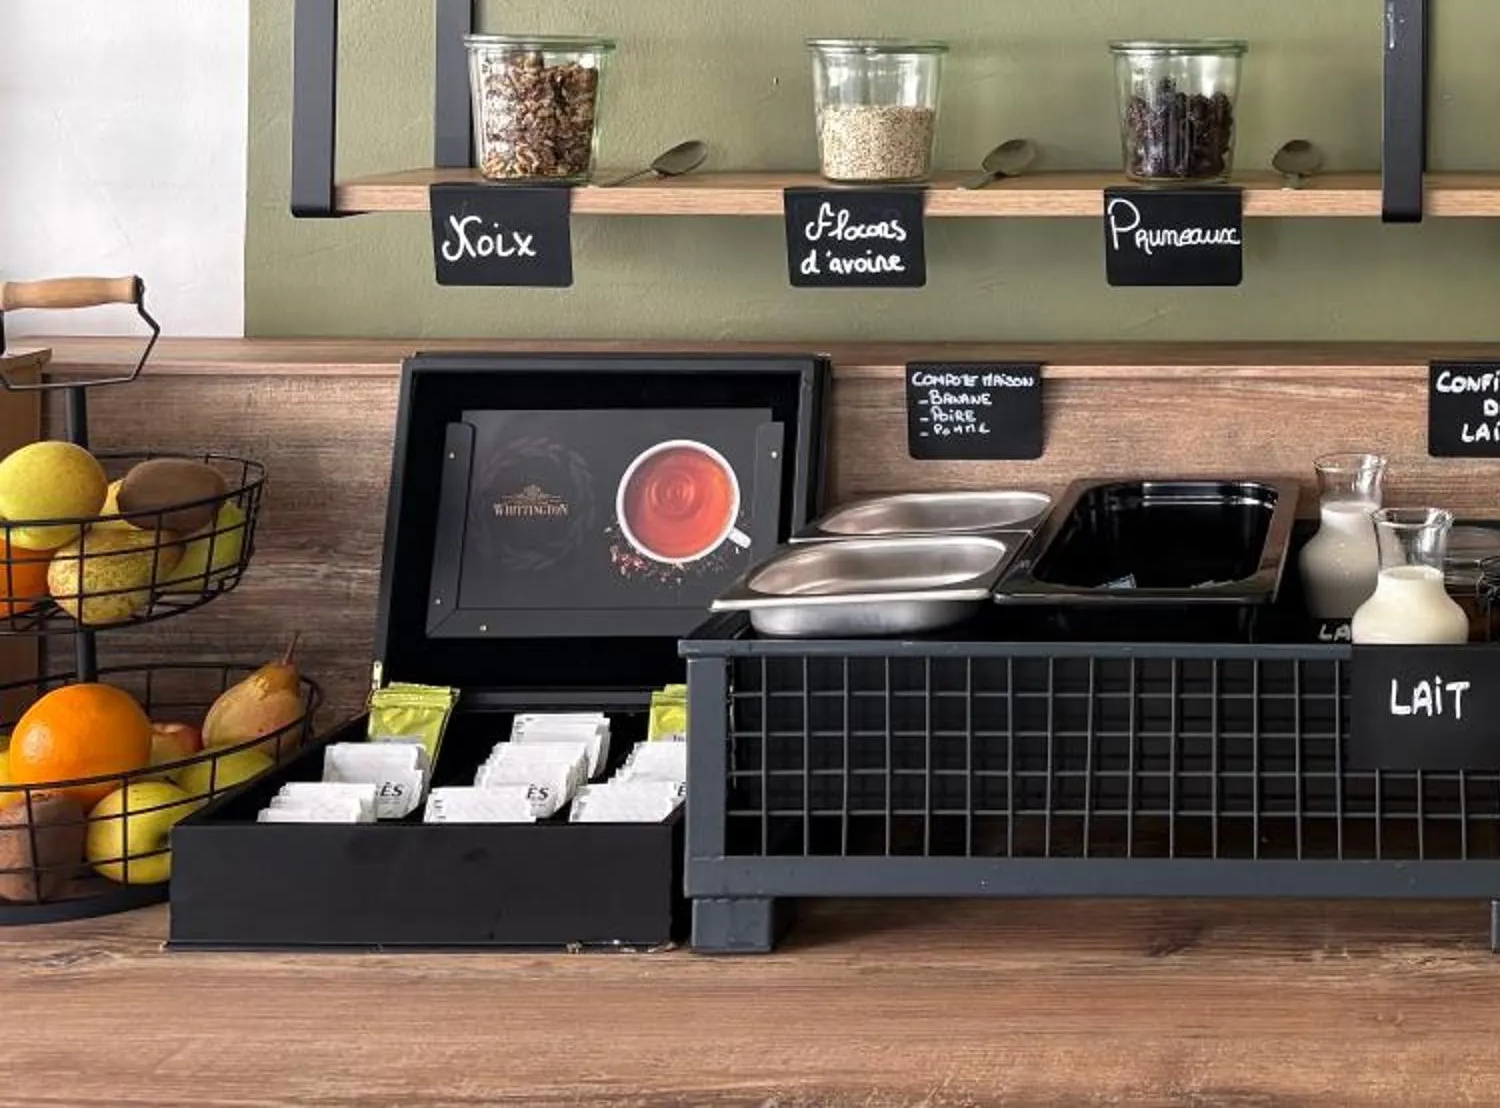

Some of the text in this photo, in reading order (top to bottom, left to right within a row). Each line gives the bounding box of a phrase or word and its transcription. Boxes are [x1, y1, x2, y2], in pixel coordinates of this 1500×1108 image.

[805, 201, 907, 241] Flocons
[1107, 198, 1241, 255] Pruneaux
[441, 215, 537, 262] Noix
[801, 249, 906, 275] d'avoine
[911, 371, 979, 387] COMPOTE
[929, 389, 993, 405] BANANE
[1318, 623, 1351, 642] LA
